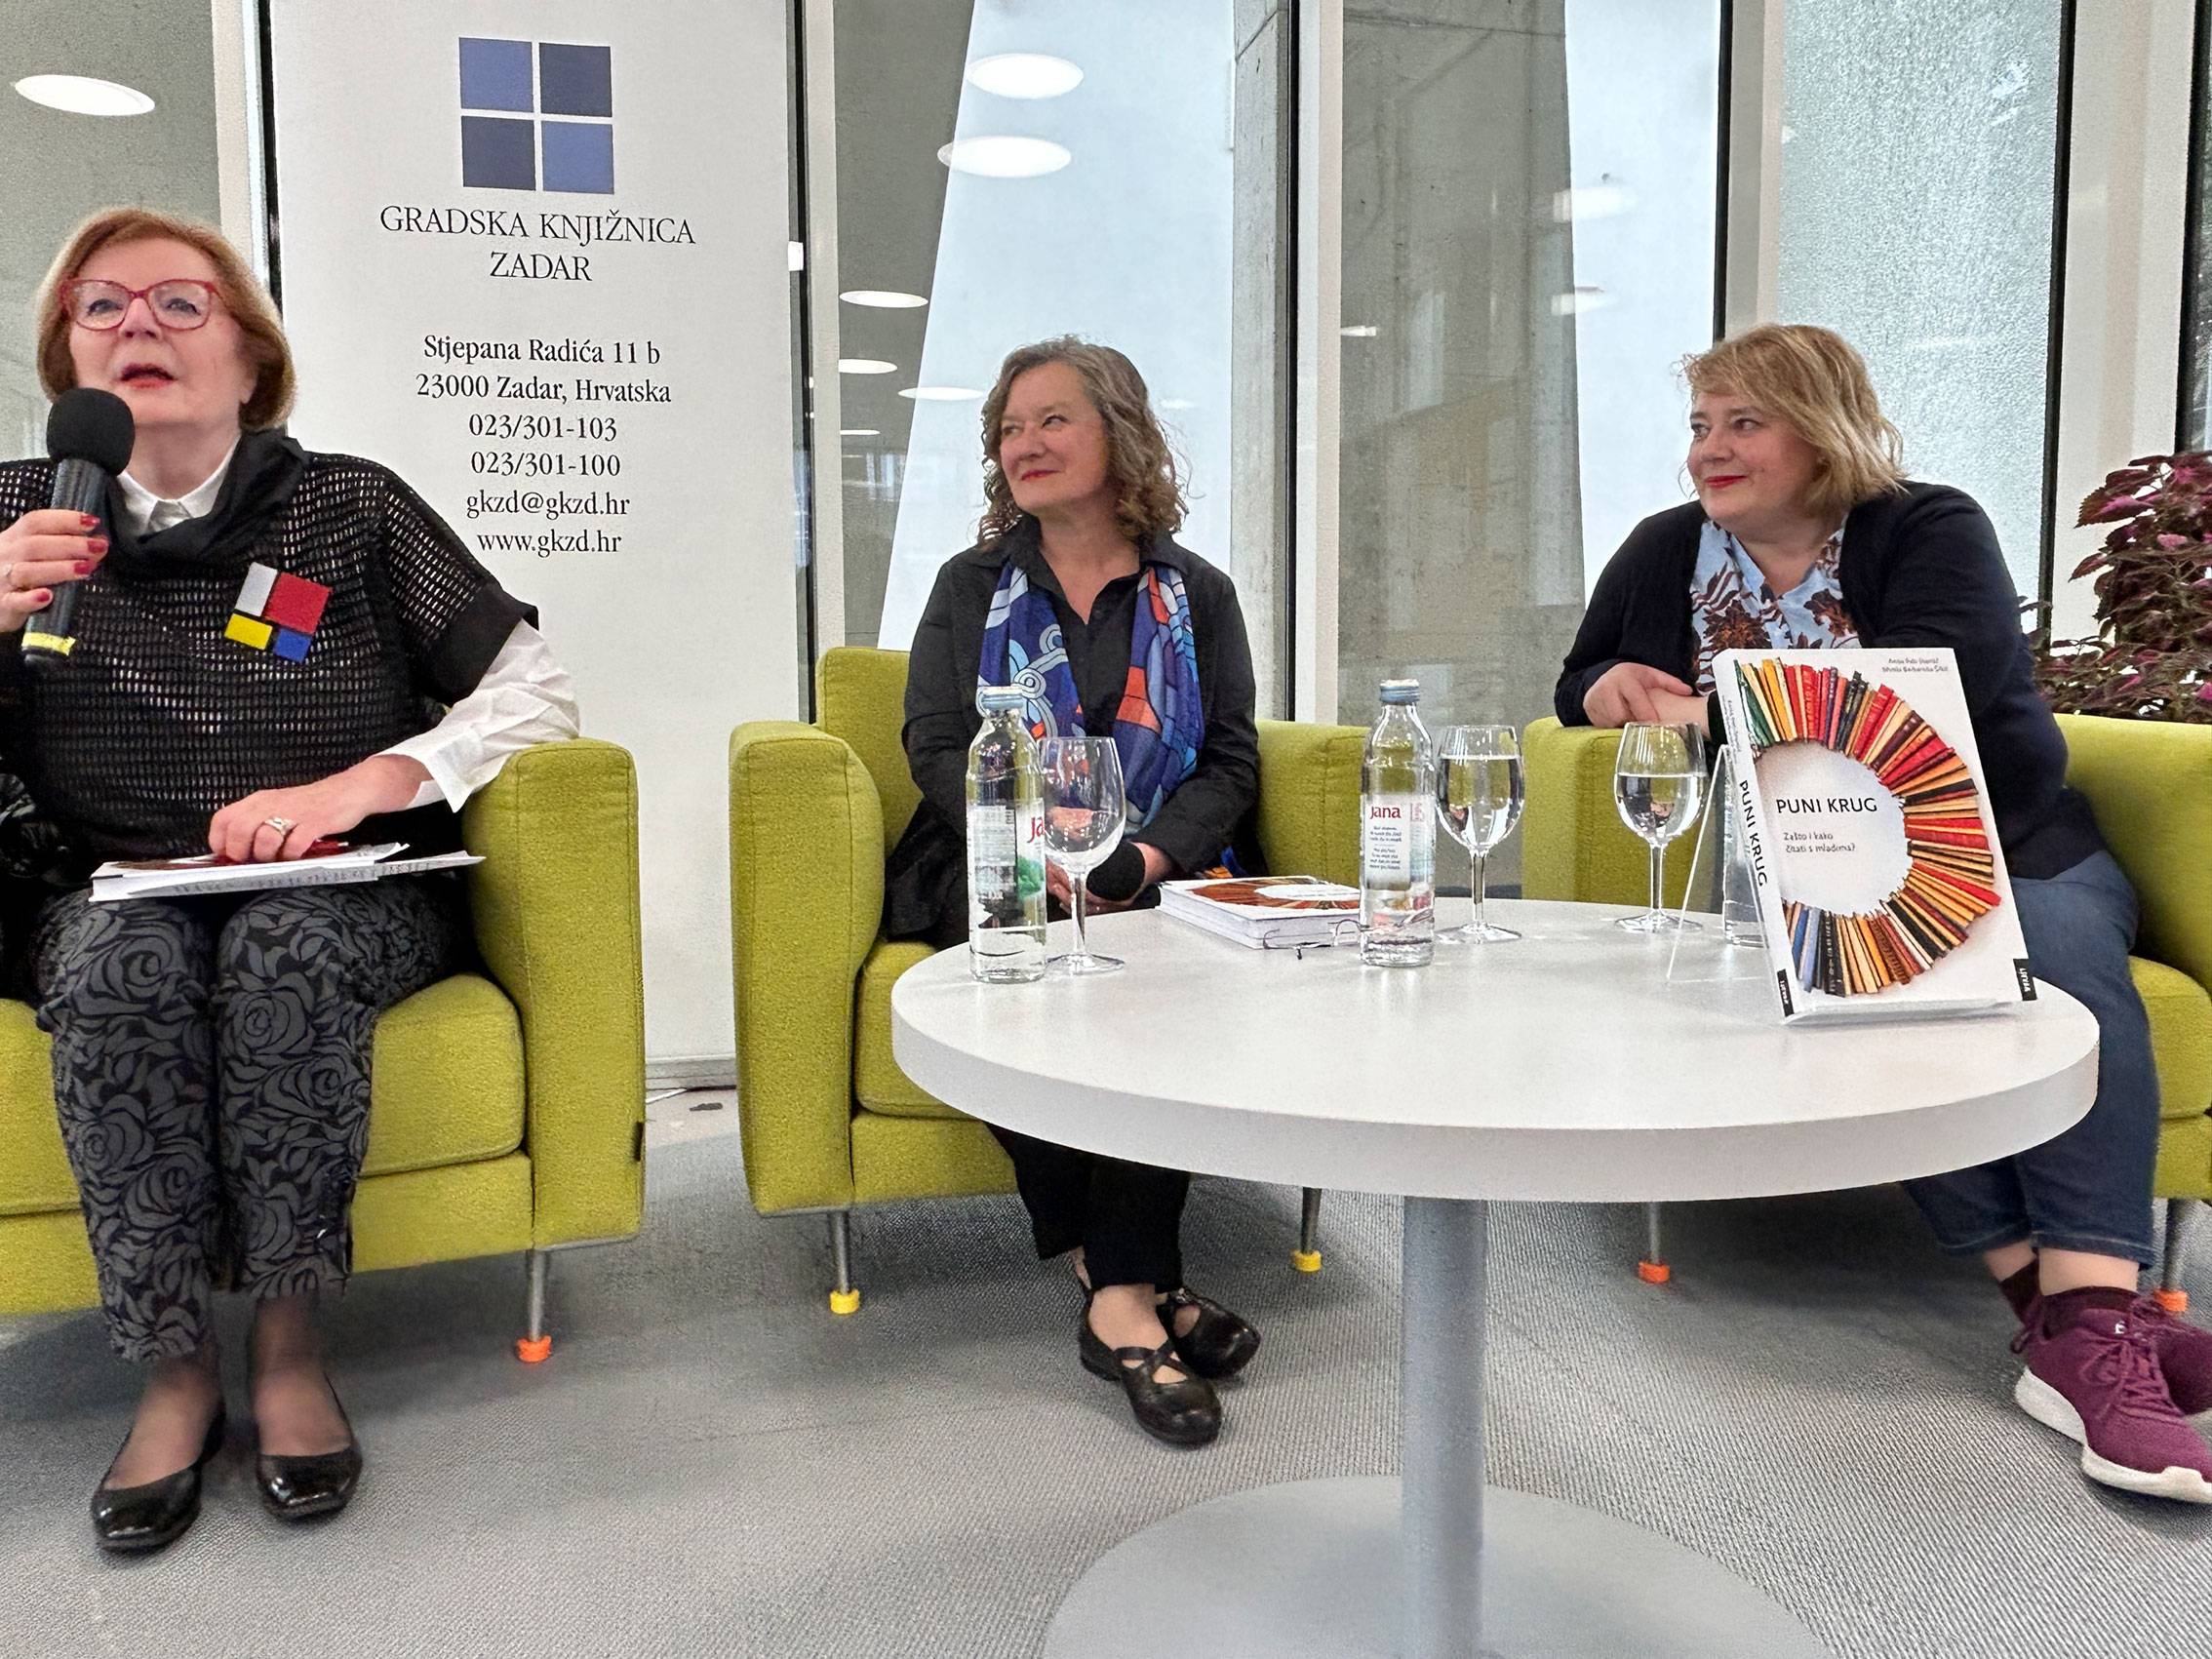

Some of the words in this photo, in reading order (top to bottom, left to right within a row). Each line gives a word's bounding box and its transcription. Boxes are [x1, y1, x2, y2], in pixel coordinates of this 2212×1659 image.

[379, 205, 530, 238] GRADSKA
[539, 209, 696, 248] KNJIŽNICA
[490, 251, 593, 282] ZADAR
[423, 335, 522, 365] Stjepana
[529, 337, 605, 363] Radića
[613, 341, 637, 364] 11
[647, 340, 660, 365] b
[415, 373, 490, 399] 23000
[496, 375, 568, 405] Zadar,
[575, 378, 672, 403] Hrvatska
[468, 414, 617, 442] 023/301-103
[471, 451, 621, 477] 023/301-100
[466, 489, 630, 521] gkzd@gkzd.hr
[477, 529, 622, 558] www.gkzd.hr
[1369, 806, 1402, 819] Jana
[1776, 799, 1822, 813] PUNI
[1827, 797, 1877, 812] KRUG
[1027, 815, 1045, 844] Ja
[1740, 780, 1756, 828] PUNI
[1750, 832, 1767, 887] KRUG
